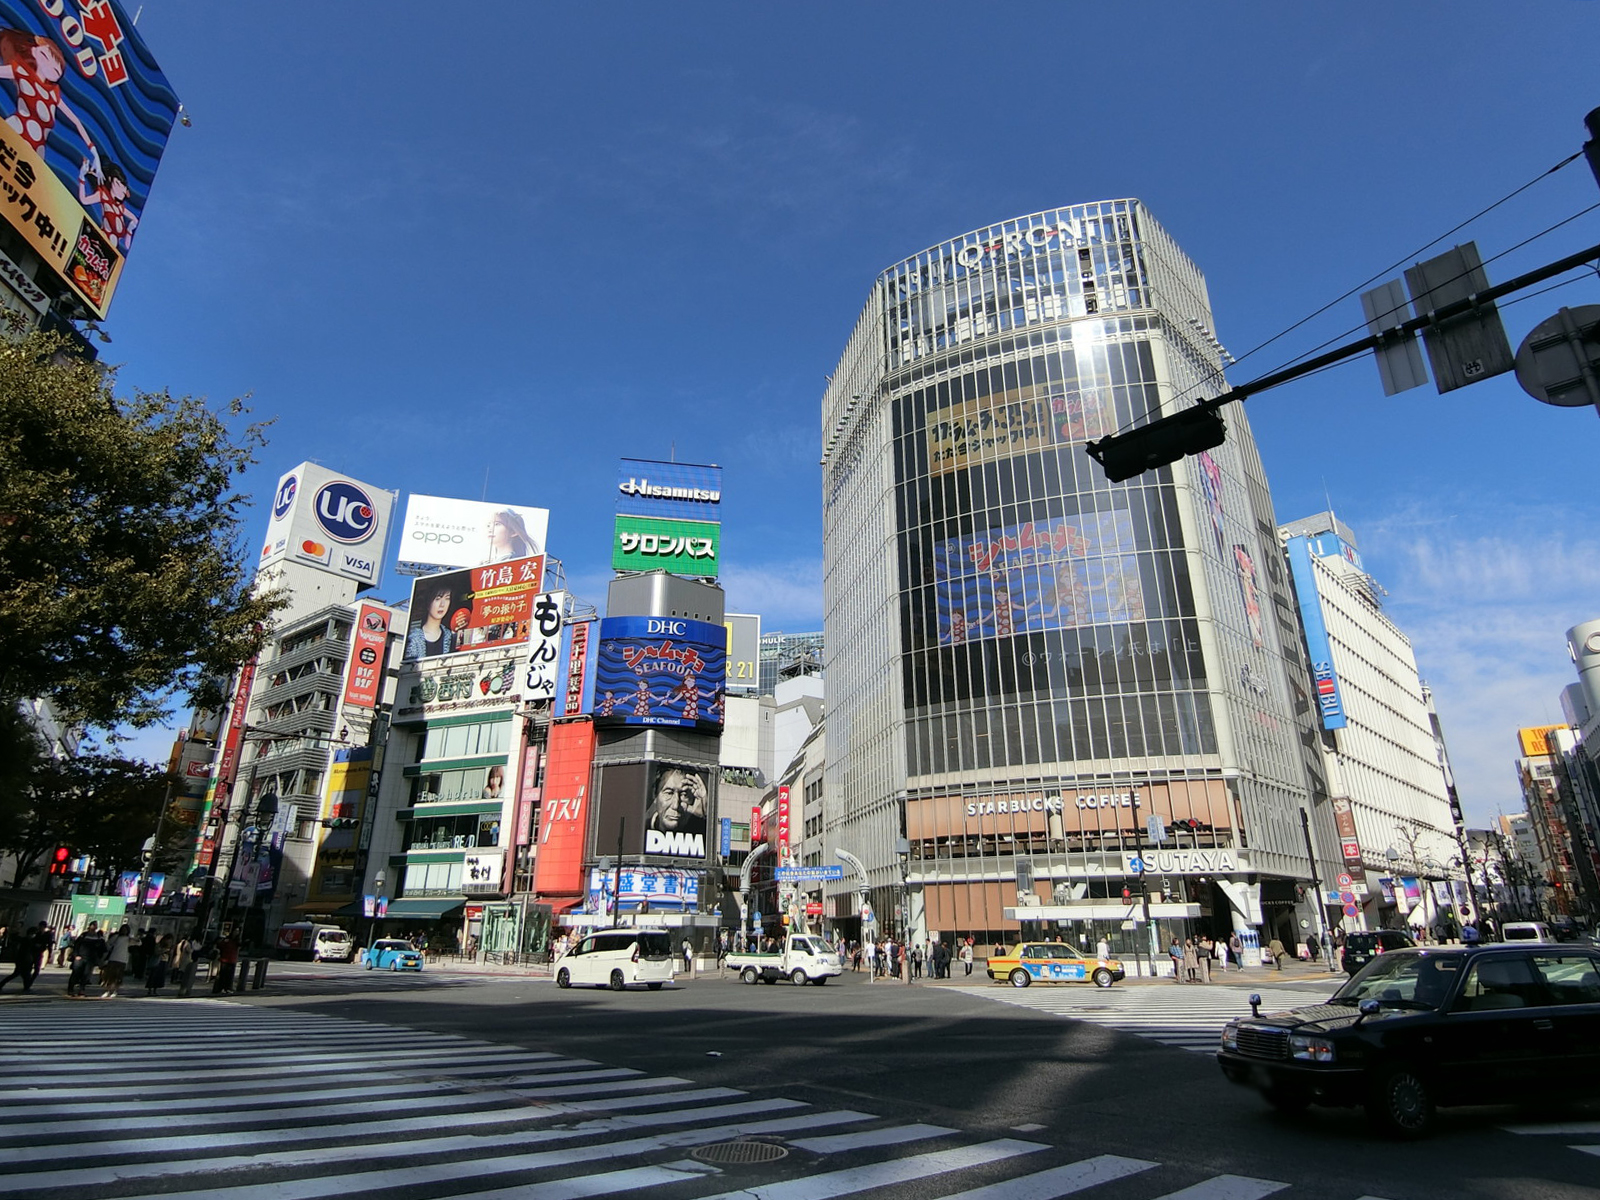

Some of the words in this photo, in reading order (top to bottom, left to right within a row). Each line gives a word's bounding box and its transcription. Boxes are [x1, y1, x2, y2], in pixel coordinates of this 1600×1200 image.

[275, 483, 296, 510] UC
[618, 477, 721, 502] Hisamitsu
[320, 489, 371, 530] UC
[619, 531, 715, 560] サロンパス
[344, 555, 371, 572] VISA
[480, 565, 514, 590] 竹島
[646, 619, 687, 636] DHC
[525, 593, 561, 696] もんじゃ
[564, 623, 588, 714] 三千里薬品
[737, 660, 754, 679] 21
[642, 716, 655, 724] DHC
[966, 796, 1064, 816] STARBUCKS
[1076, 792, 1141, 808] COFFEE
[645, 829, 705, 857] DMM
[598, 872, 699, 895] 大盛堂書店
